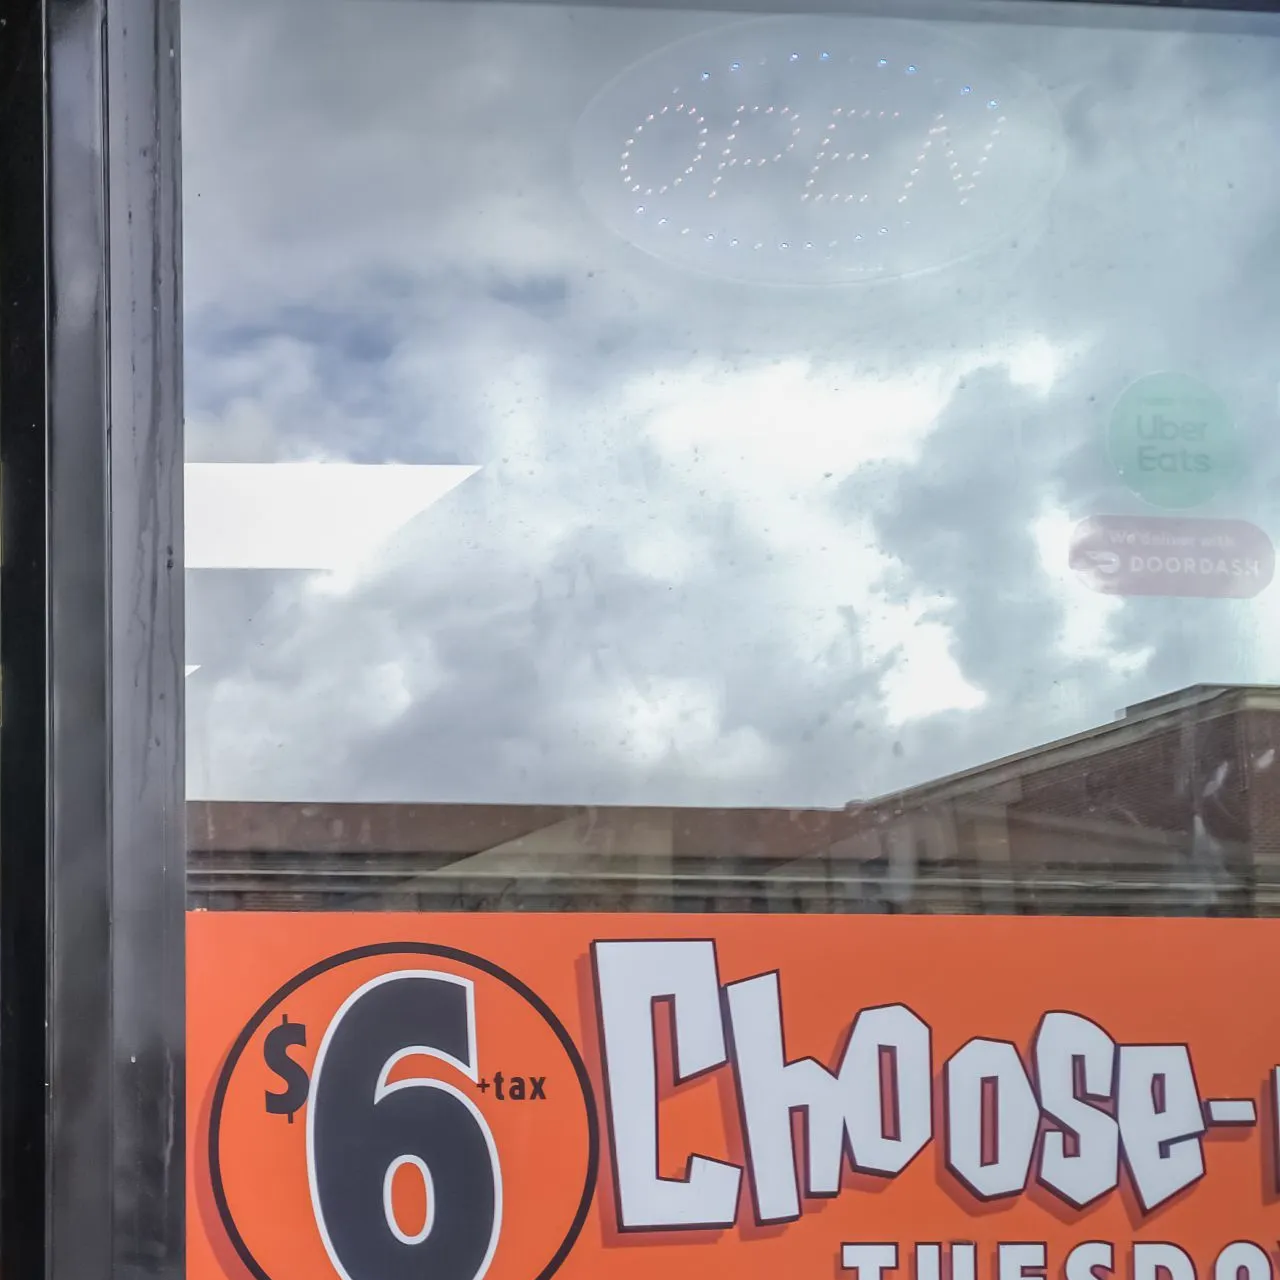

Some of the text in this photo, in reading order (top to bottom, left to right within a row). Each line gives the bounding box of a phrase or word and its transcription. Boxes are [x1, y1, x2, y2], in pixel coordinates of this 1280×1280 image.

[621, 105, 1005, 204] OPEN
[1136, 414, 1209, 442] Uber
[1136, 446, 1212, 473] Eats
[1130, 556, 1259, 576] DOORDASH
[591, 938, 1280, 1232] Choose-
